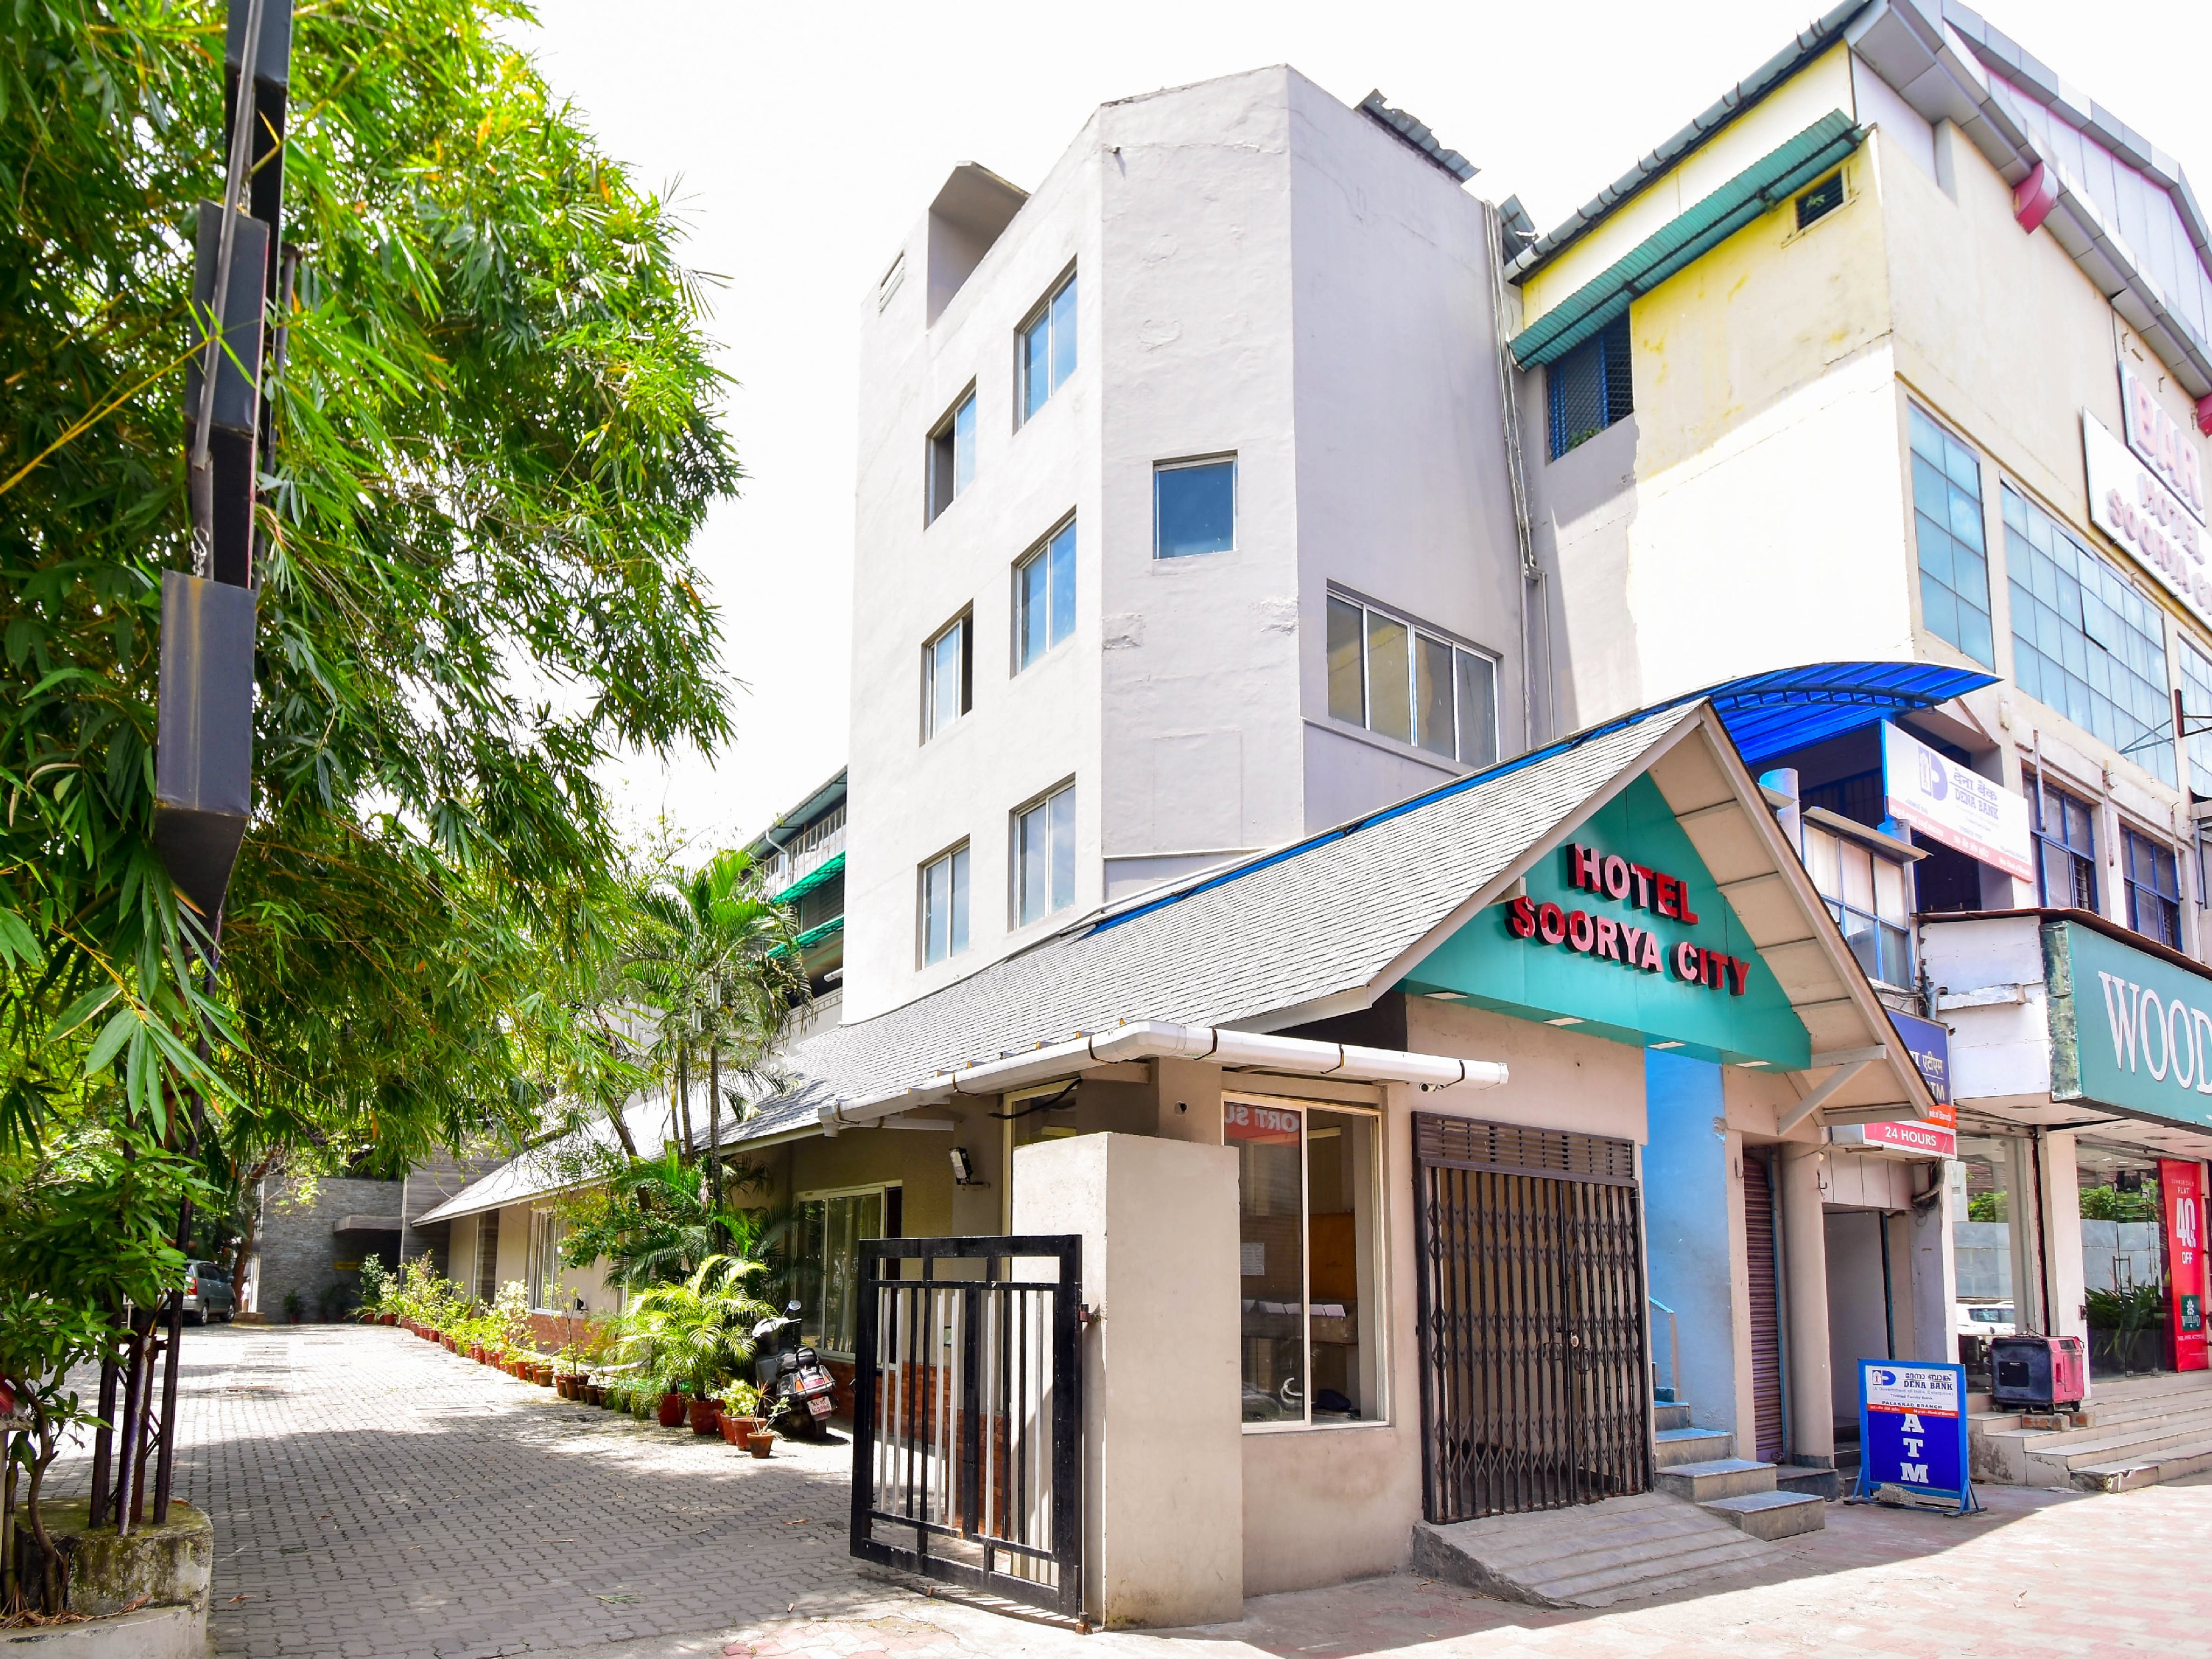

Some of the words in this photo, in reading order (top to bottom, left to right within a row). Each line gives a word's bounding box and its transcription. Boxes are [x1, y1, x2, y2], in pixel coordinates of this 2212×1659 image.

[2128, 377, 2203, 512] BAR
[2137, 473, 2205, 565] HOTEL
[2107, 488, 2191, 594] SOORYA
[1953, 768, 1974, 790] देना
[1977, 779, 1998, 801] बैंक
[1954, 787, 1976, 810] DENA
[1978, 798, 1999, 820] BANK
[1566, 843, 1699, 925] HOTEL
[1504, 895, 1663, 973] SOORYA
[1670, 941, 1751, 996] CITY
[1926, 1080, 1946, 1101] TM
[1885, 1126, 1898, 1139] 24
[1901, 1129, 1937, 1146] HOURS
[2177, 1186, 2189, 1194] FLAT
[2181, 1251, 2193, 1264] OFF
[1904, 1380, 1926, 1389] DENA
[1930, 1382, 1953, 1391] BANK
[1900, 1413, 1930, 1483] ATM
